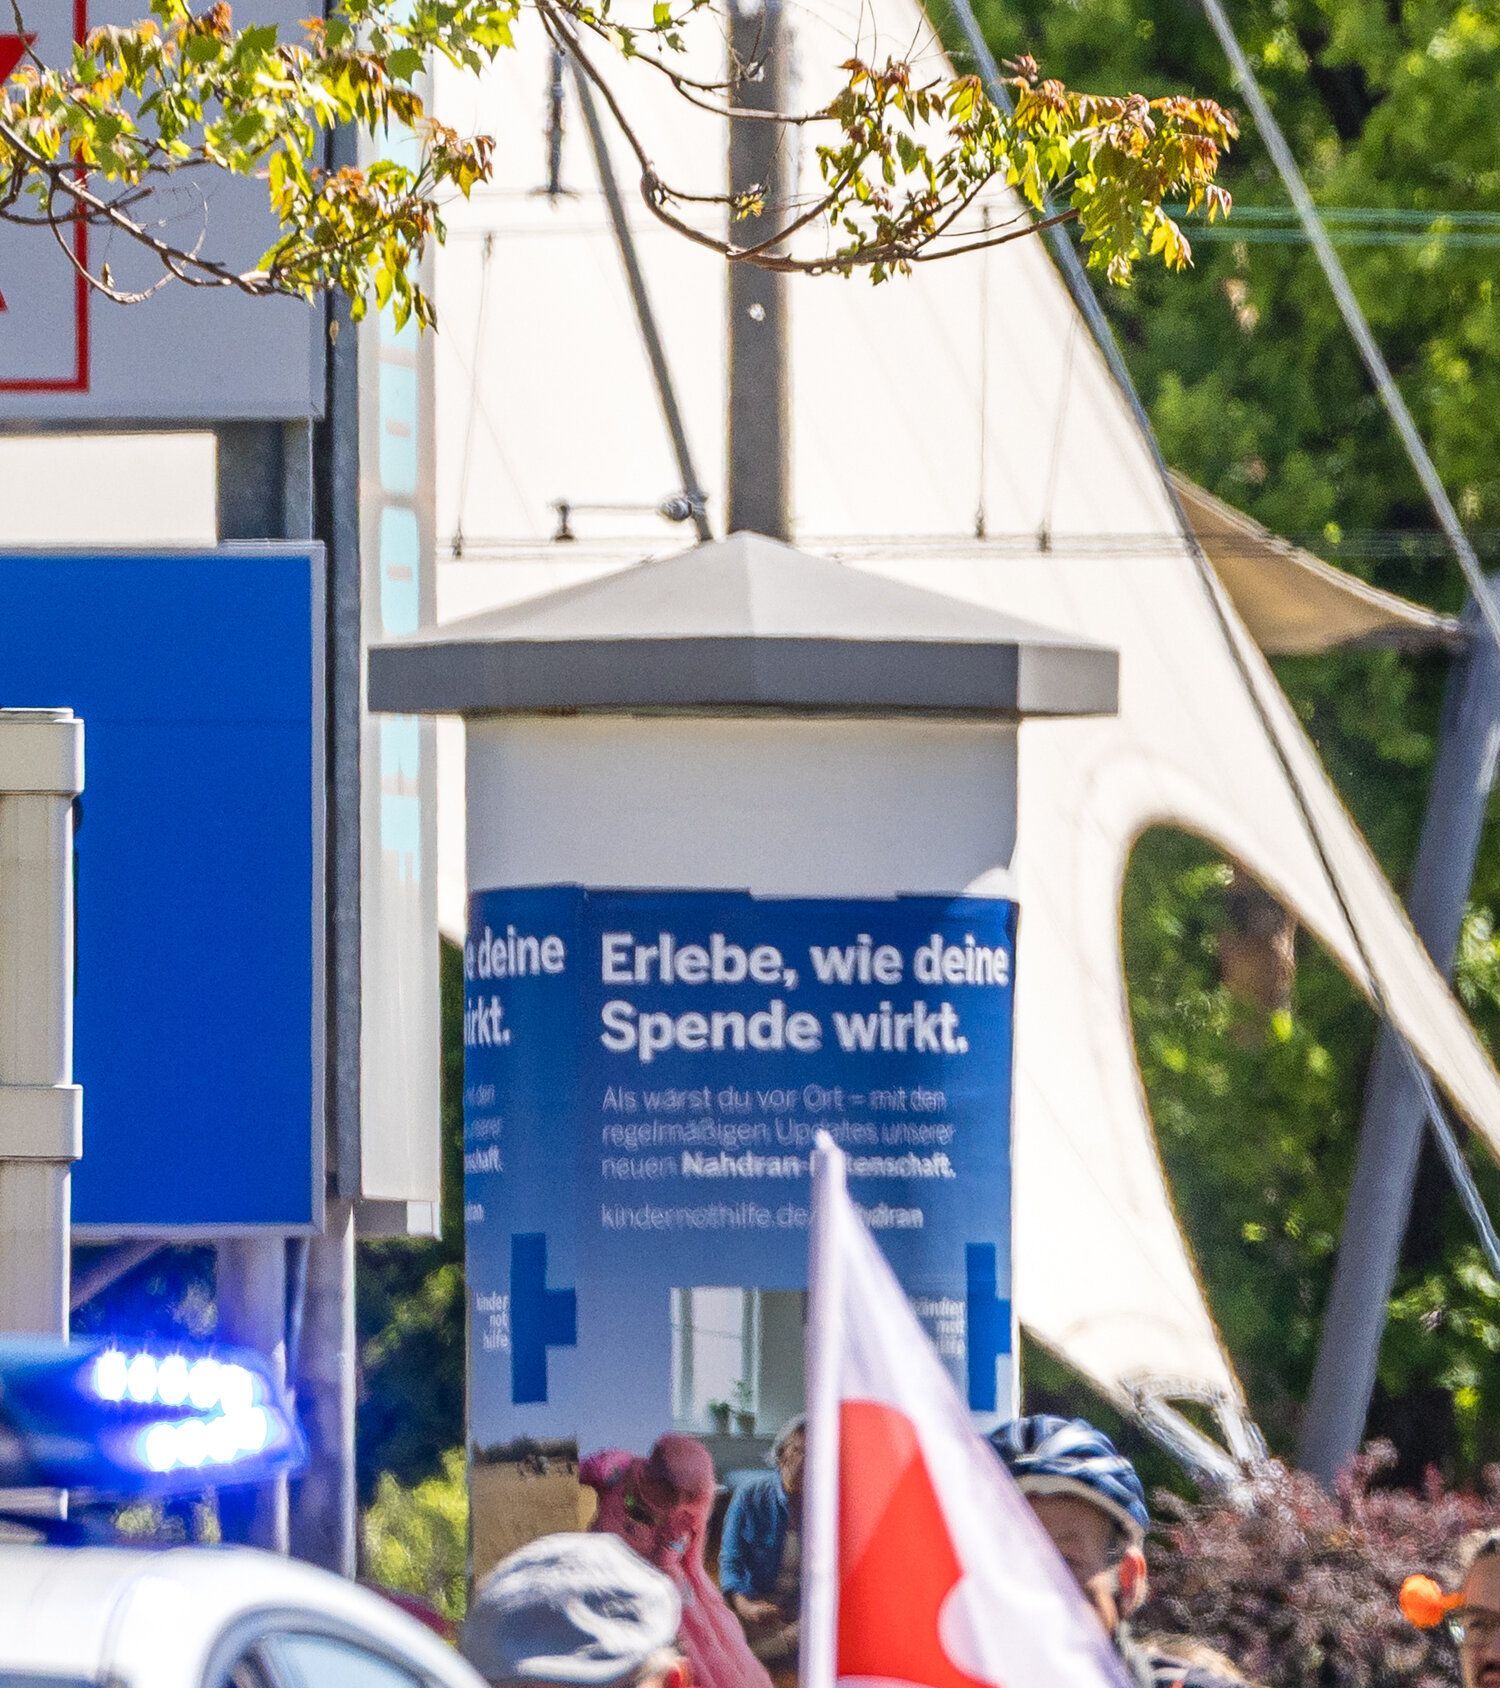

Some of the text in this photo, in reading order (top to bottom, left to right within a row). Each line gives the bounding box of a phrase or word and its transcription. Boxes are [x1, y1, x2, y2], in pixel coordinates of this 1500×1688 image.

[478, 925, 566, 978] deine
[602, 931, 1009, 990] Erlebe, wie deine
[601, 1000, 968, 1063] Spende wirkt.
[602, 1086, 636, 1112] Als
[717, 1085, 750, 1111] du
[757, 1089, 796, 1110] vor
